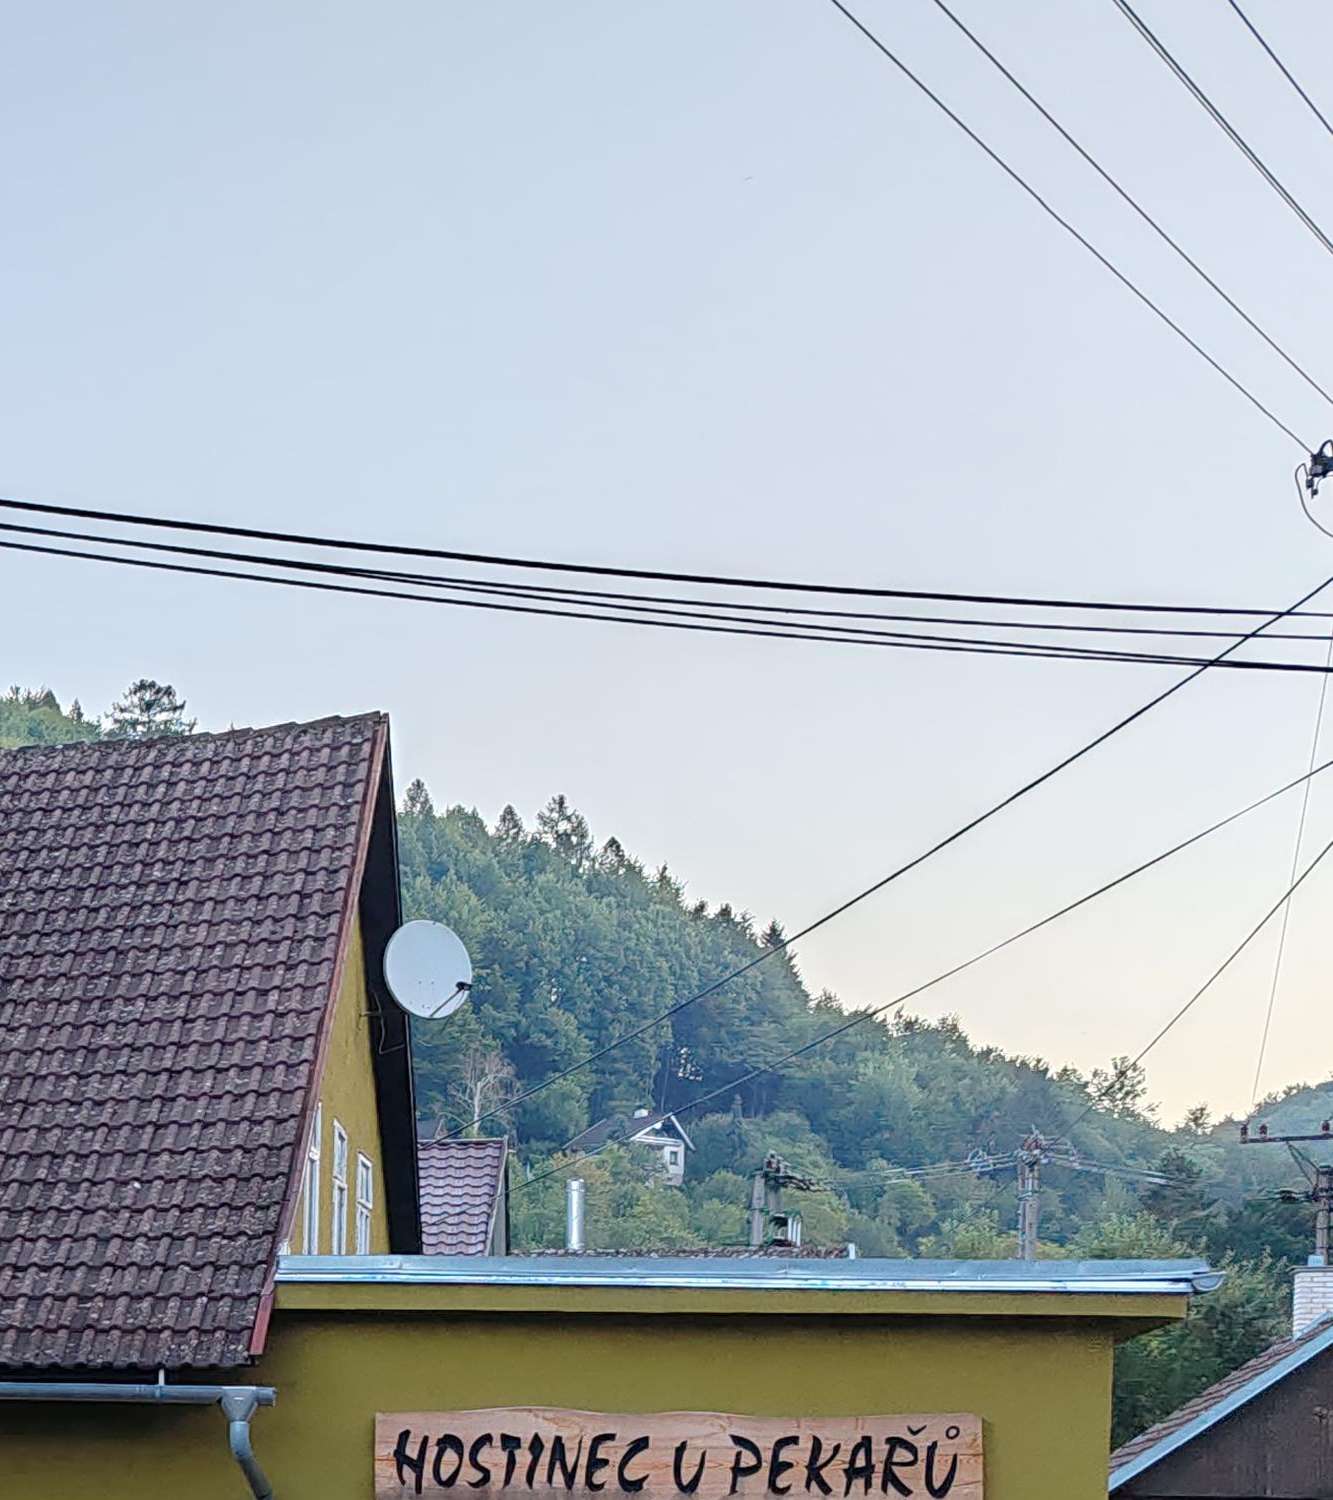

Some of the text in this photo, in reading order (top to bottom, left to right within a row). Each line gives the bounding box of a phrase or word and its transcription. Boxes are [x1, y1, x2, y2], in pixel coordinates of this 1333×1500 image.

[393, 1424, 960, 1499] HOSTINEC U PEKAŘŮ
